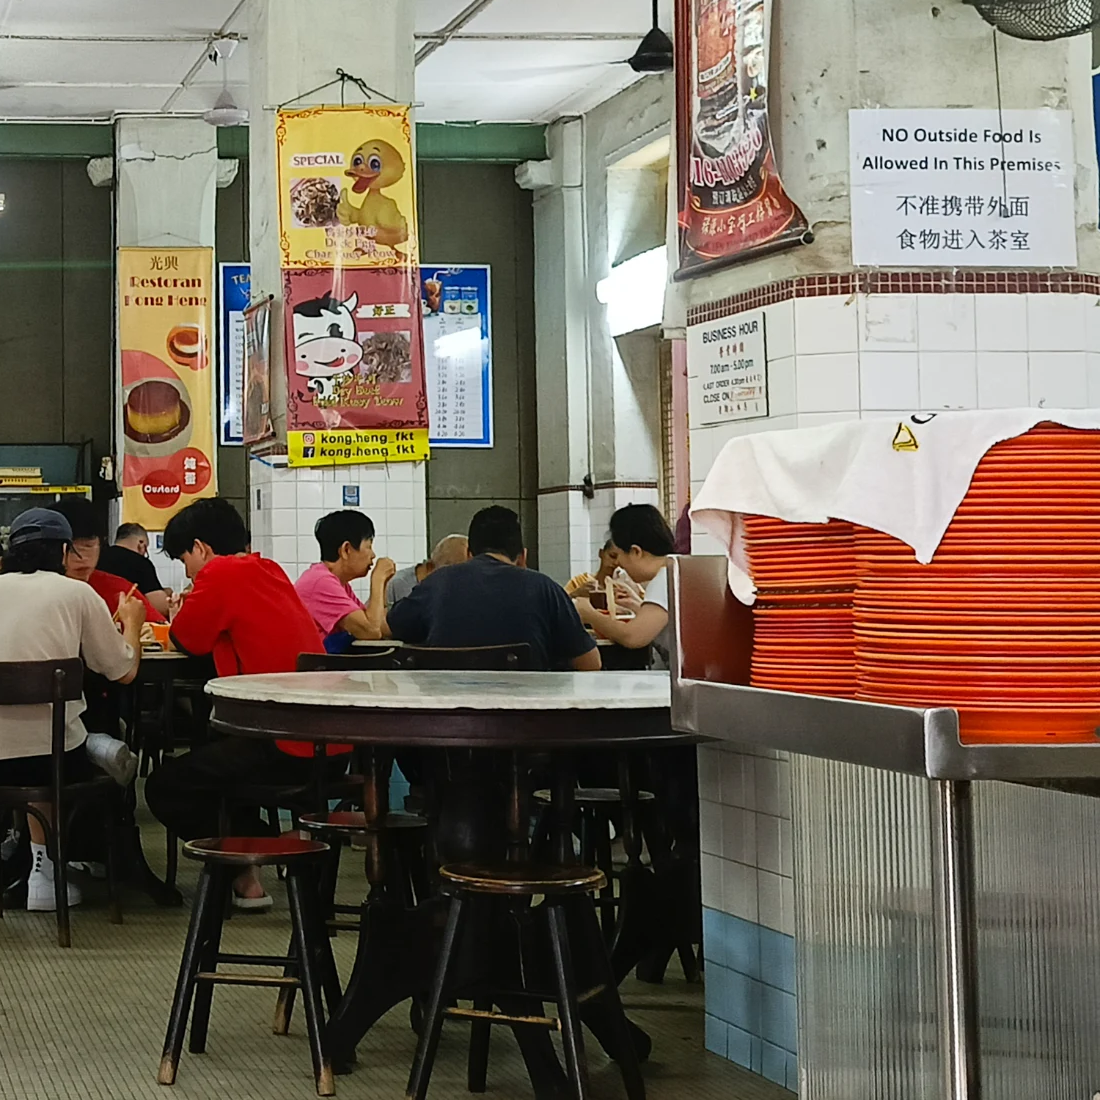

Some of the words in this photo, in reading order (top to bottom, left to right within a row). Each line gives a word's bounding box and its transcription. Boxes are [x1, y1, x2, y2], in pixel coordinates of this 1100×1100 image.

[881, 128, 908, 142] NO
[914, 128, 978, 143] Outside
[983, 129, 1023, 143] Food
[1029, 130, 1042, 143] Is
[293, 155, 343, 166] SPECIAL
[862, 156, 928, 170] Allowed
[934, 157, 948, 170] In
[953, 157, 985, 171] This
[990, 158, 1061, 172] Premises
[895, 195, 1030, 218] 不准携带外面
[325, 238, 352, 248] Duk
[896, 229, 1031, 251] 食物进入茶室
[130, 276, 202, 288] Restoran
[702, 325, 737, 344] BUSINESS
[739, 320, 759, 336] HOUR
[321, 432, 415, 445] kong.heng_fkt
[320, 444, 416, 458] kong.heng_fkt
[143, 484, 180, 493] Custard
